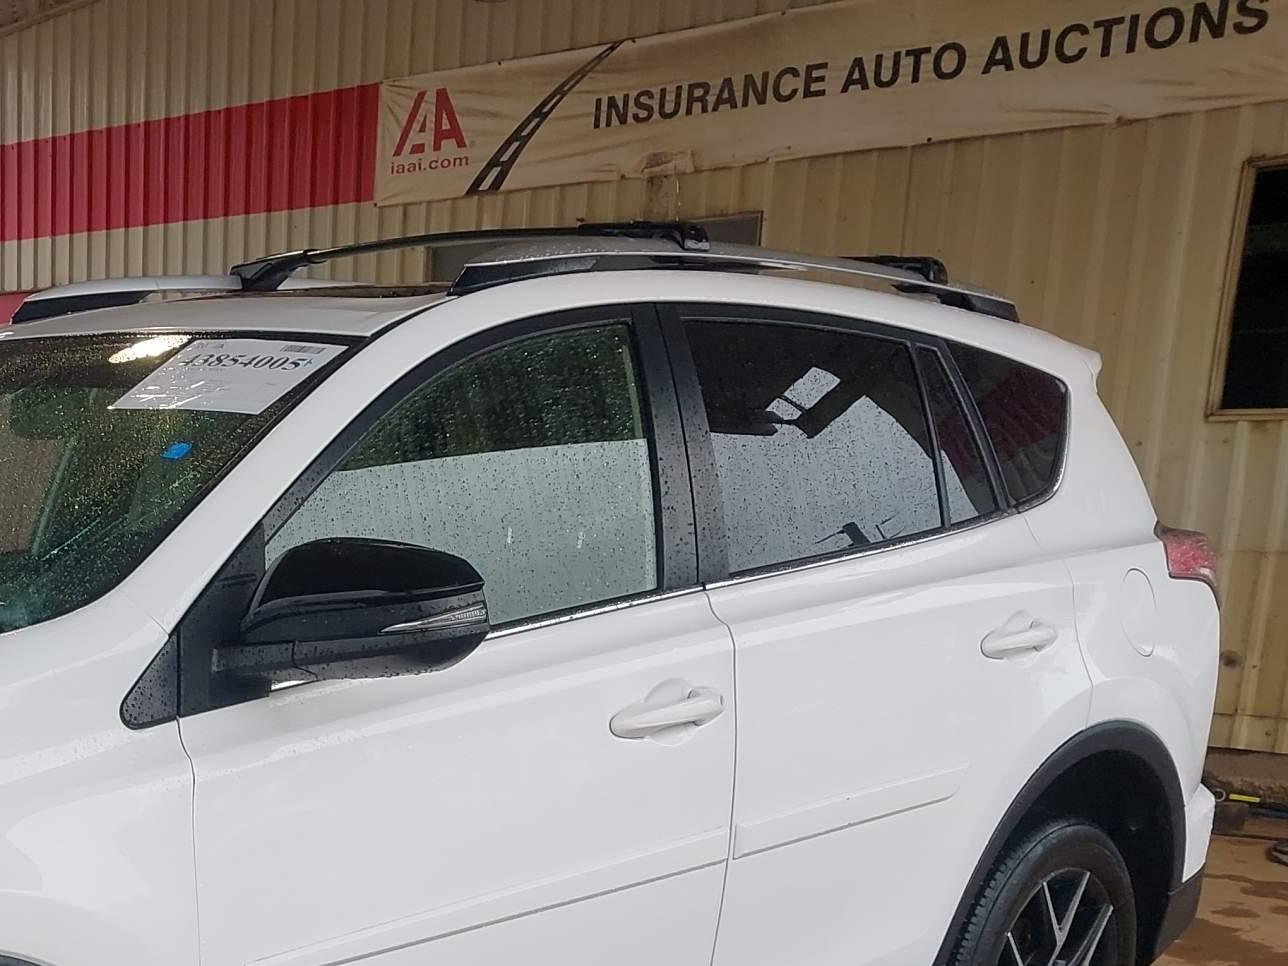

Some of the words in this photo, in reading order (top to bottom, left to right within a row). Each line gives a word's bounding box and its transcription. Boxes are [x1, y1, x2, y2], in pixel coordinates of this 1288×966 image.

[593, 61, 829, 130] INSURANCE
[839, 41, 967, 93] AUTO
[980, 0, 1270, 76] AUCTIONS
[390, 155, 470, 175] iaai.com
[180, 353, 308, 371] 43854005
